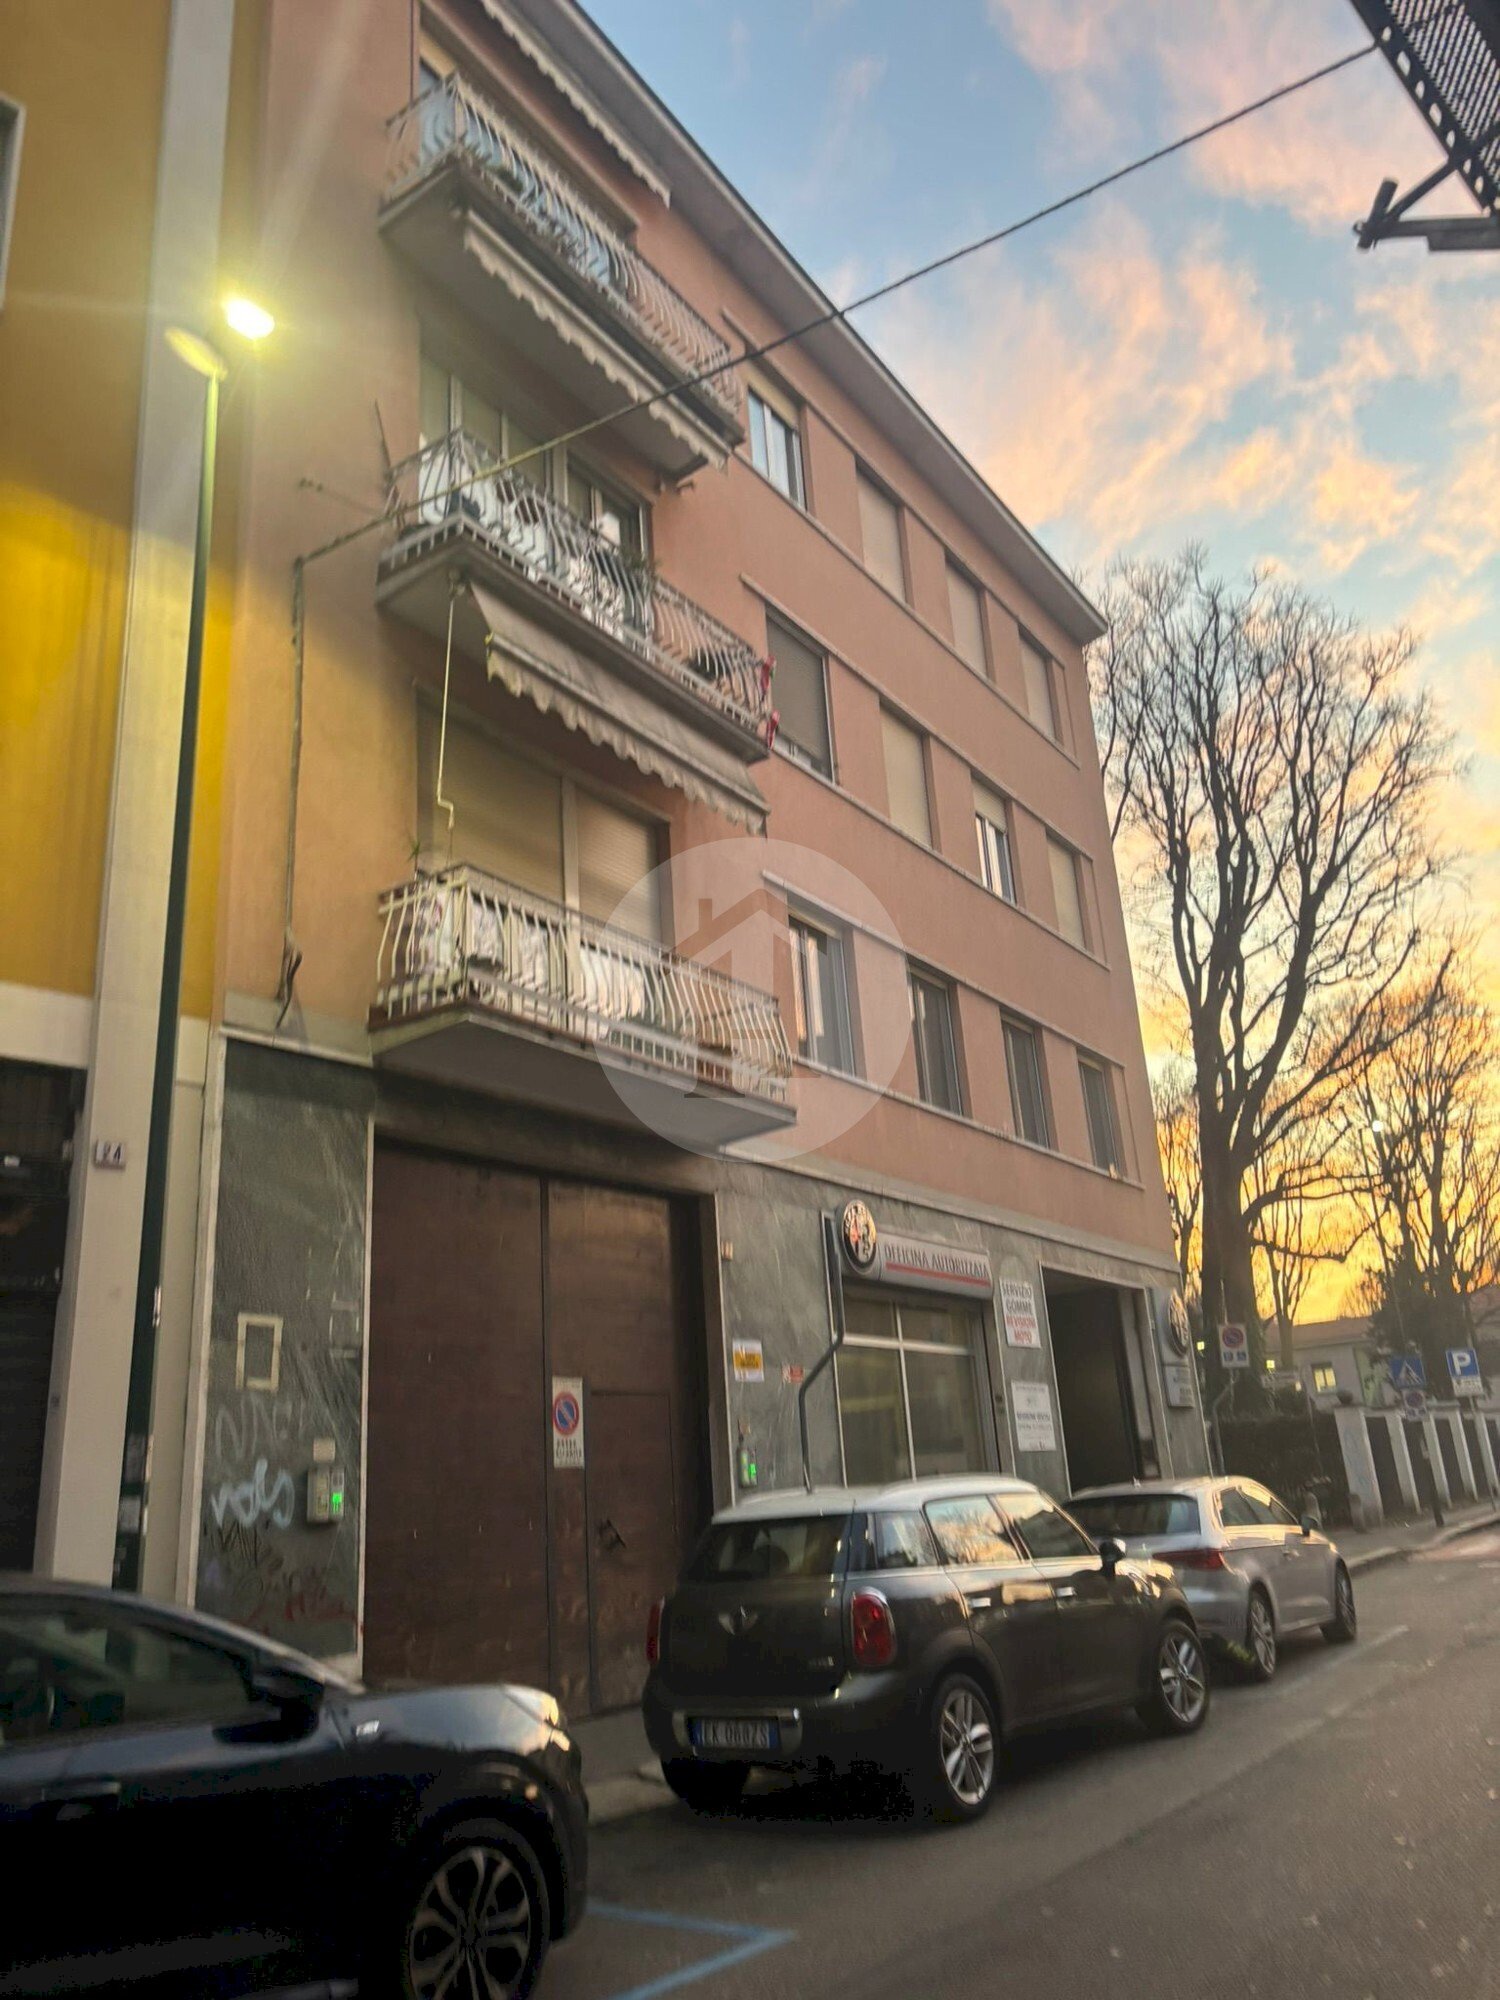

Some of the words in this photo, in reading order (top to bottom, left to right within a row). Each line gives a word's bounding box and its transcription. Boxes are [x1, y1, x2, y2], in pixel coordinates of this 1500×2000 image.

[884, 1243, 930, 1269] OFFICINA
[932, 1252, 989, 1279] AUTORIZZATA
[1001, 1280, 1032, 1299] SERVIZIO
[1005, 1297, 1034, 1316] GOMME
[1452, 1352, 1471, 1376] P
